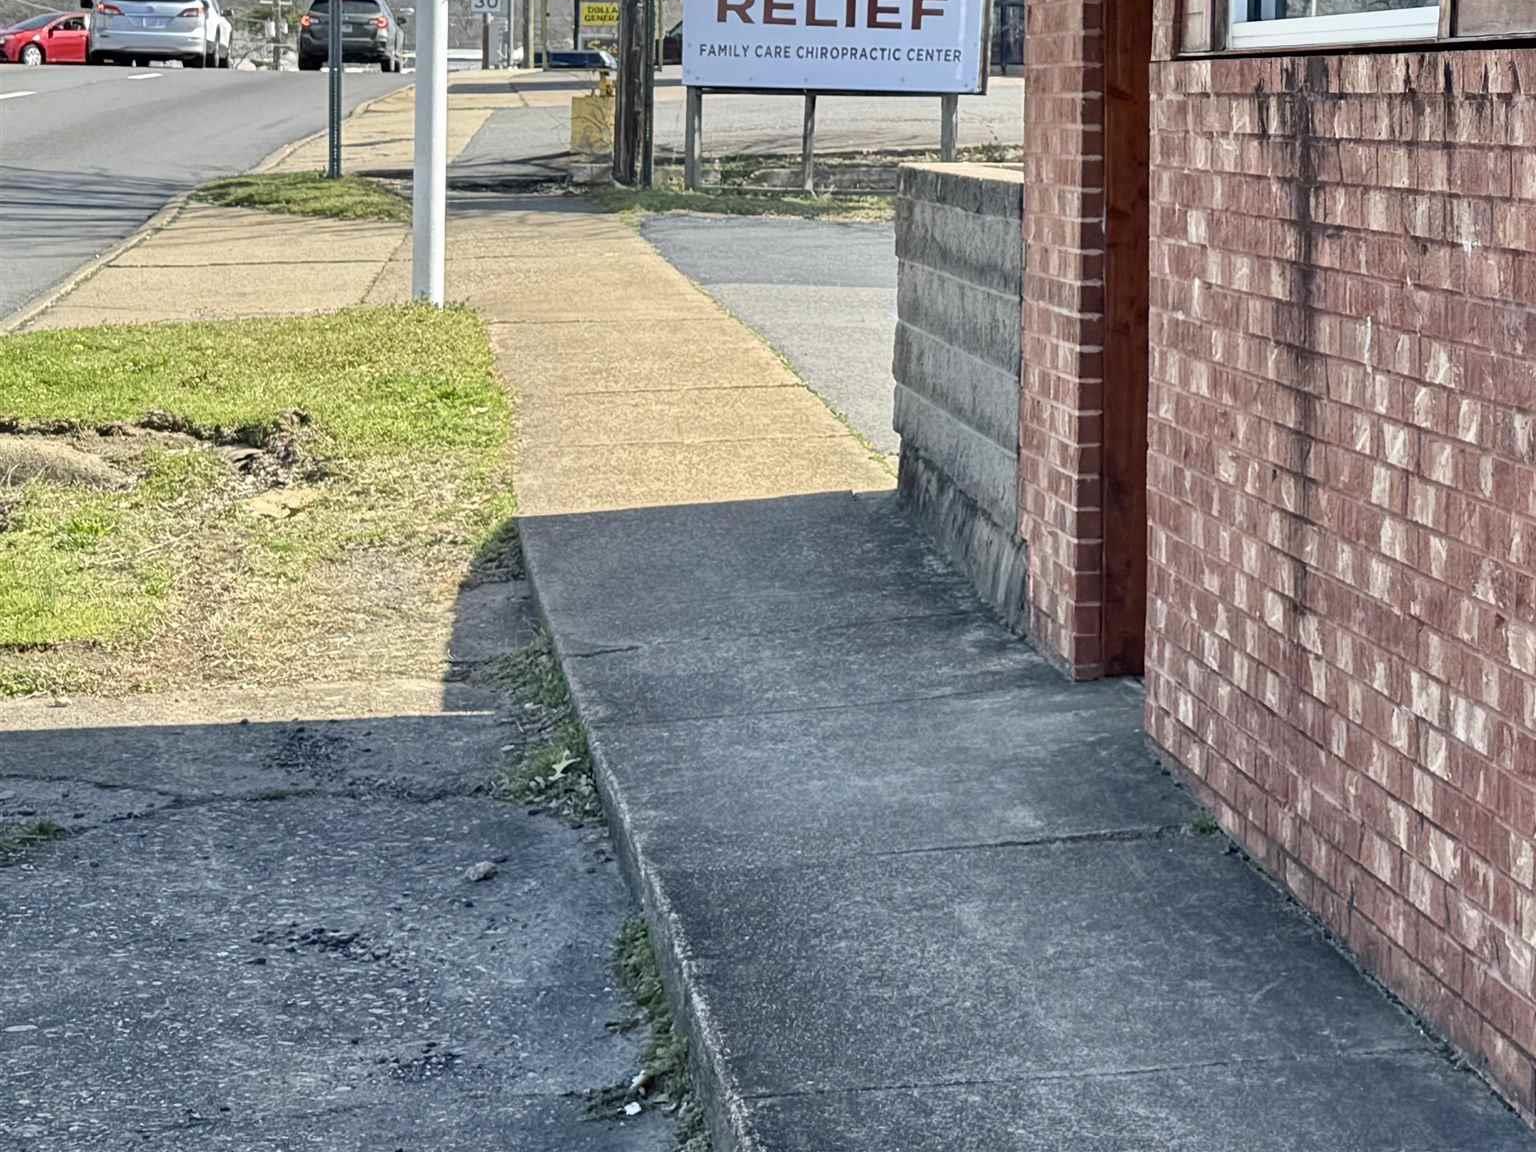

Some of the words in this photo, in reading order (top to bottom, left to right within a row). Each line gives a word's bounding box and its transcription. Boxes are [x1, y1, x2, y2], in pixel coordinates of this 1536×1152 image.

[587, 6, 618, 14] DOLLA
[699, 43, 750, 58] FAMILY
[755, 45, 791, 59] CARE
[796, 45, 901, 62] CHIROPRACTIC
[906, 47, 963, 63] CENTER
